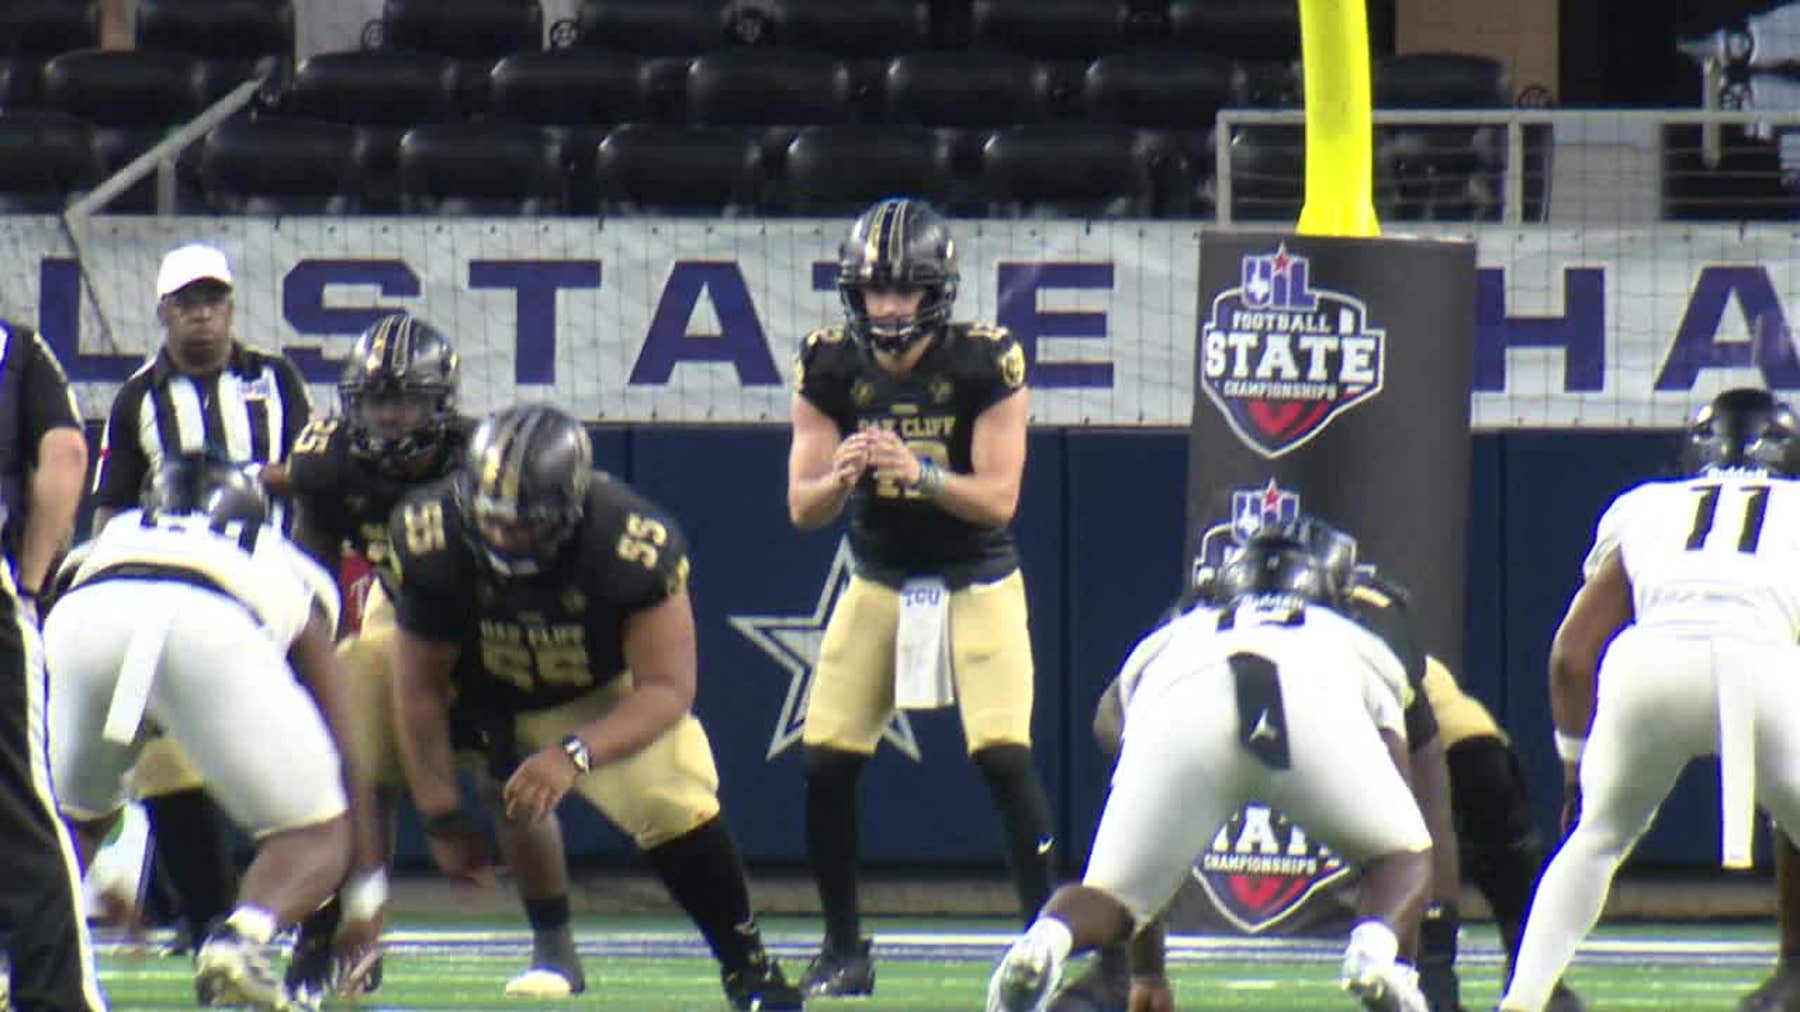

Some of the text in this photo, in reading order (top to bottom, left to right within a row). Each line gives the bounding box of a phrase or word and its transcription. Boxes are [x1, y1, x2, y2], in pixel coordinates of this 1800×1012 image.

[282, 258, 1114, 388] STAE
[1232, 309, 1332, 334] FOOTBALL
[1205, 331, 1377, 383] STATE
[1223, 379, 1337, 401] CHAMPIONSHIPS
[901, 415, 957, 438] CLIFF
[1684, 483, 1772, 556] 11
[616, 512, 667, 569] 55
[902, 587, 941, 607] TCU
[1203, 853, 1318, 876] CHAMPIONSHIPS
